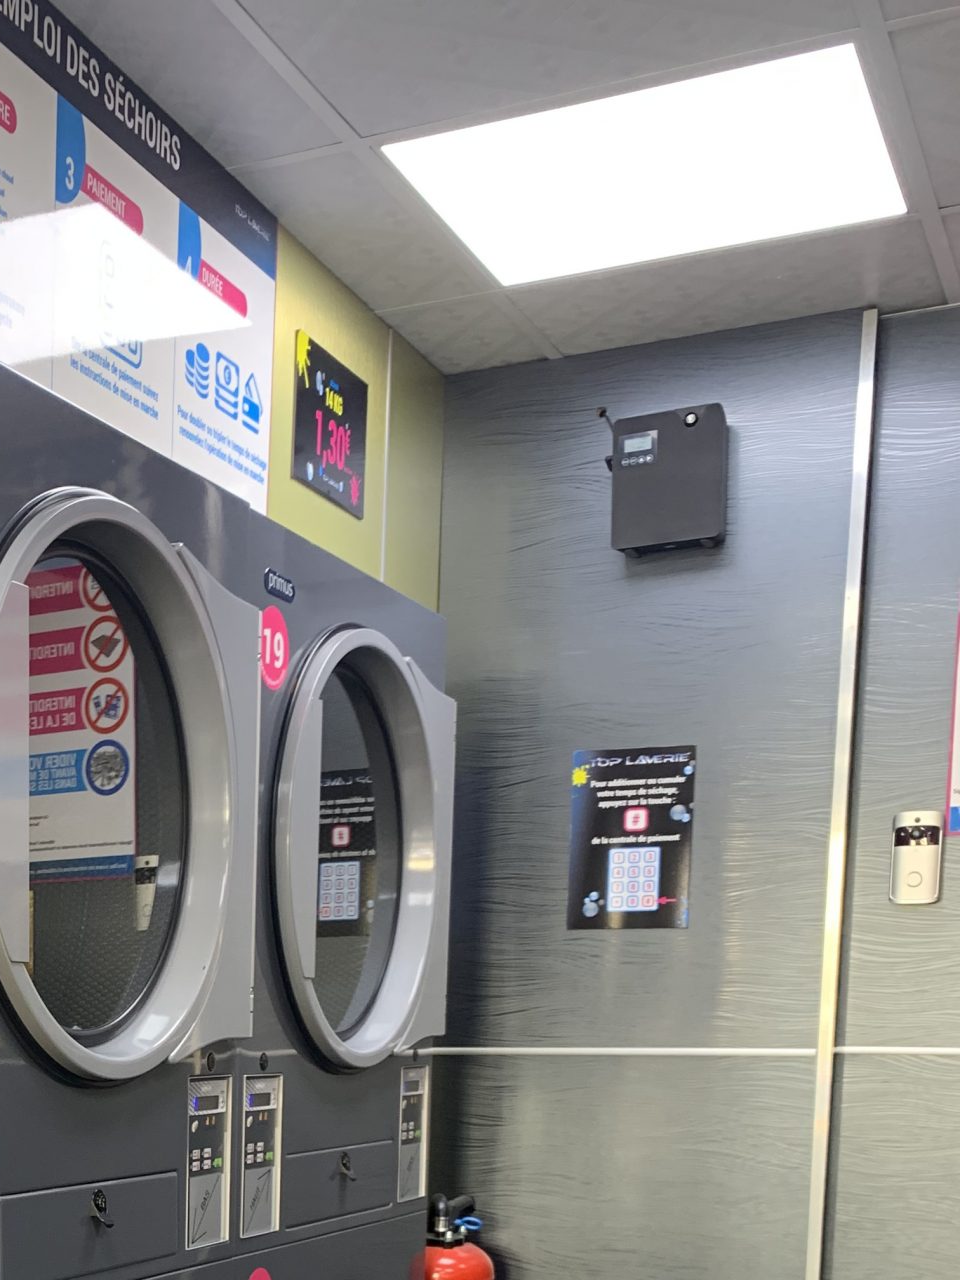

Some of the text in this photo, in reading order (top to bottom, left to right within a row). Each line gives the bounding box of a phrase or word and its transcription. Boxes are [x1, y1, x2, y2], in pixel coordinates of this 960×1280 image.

[66, 35, 100, 97] DES
[104, 73, 181, 171] SÉCHOIRS
[65, 156, 75, 190] 3
[87, 173, 126, 219] PAIEMENT
[202, 266, 224, 297] DURÉE
[268, 572, 294, 598] primus
[263, 627, 284, 669] 19
